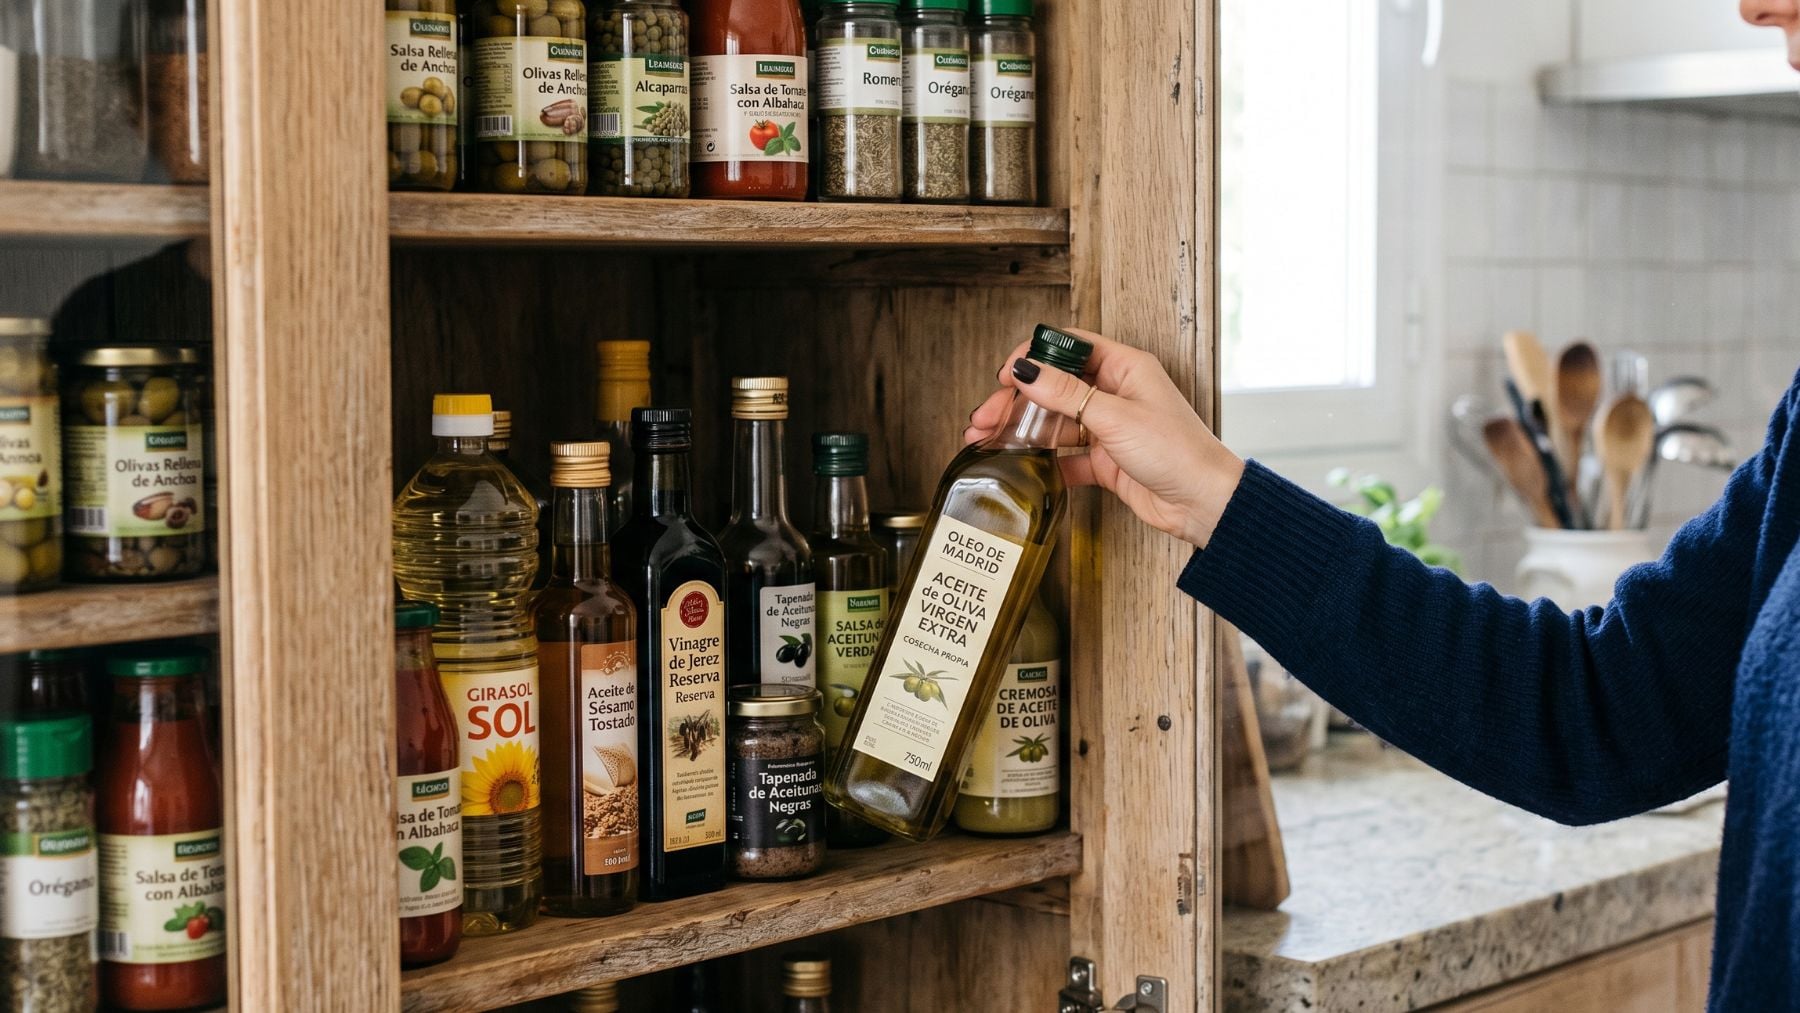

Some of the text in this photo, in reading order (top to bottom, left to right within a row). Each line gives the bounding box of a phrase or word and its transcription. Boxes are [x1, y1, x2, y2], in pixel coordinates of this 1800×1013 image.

[390, 43, 424, 57] Salsa
[400, 58, 418, 71] de
[522, 66, 561, 80] Olivas
[538, 81, 554, 94] de
[730, 83, 761, 95] Salsa
[763, 83, 778, 95] de
[737, 96, 805, 110] con Albahaca
[115, 458, 160, 473] Olivas
[131, 474, 150, 488] de
[947, 531, 1006, 563] OLEO DE
[942, 543, 999, 574] MADRID
[932, 572, 988, 602] ACEITE
[922, 586, 986, 620] de OLIVA
[766, 606, 779, 617] de
[921, 599, 978, 633] VIRGEN
[781, 617, 811, 629] Negras
[836, 620, 874, 631] SALSA
[827, 632, 879, 645] ACEITUN
[918, 617, 967, 647] EXTRA
[668, 636, 720, 652] Vinagre
[903, 635, 969, 668] COSECHA PROPIA
[669, 654, 719, 671] de Jerez
[669, 671, 720, 688] Reserva
[466, 682, 533, 702] GIRASOL
[588, 682, 635, 699] Aceite de
[675, 690, 716, 704] Reserva
[999, 685, 1057, 701] CREMOSA
[589, 699, 635, 715] Sésamo
[997, 699, 1057, 715] DE ACEITE
[467, 701, 536, 740] SOL
[588, 713, 635, 731] Tostado
[1000, 714, 1056, 729] DE OLIVA
[904, 751, 933, 772] 750ml
[759, 768, 817, 787] Tapenada
[748, 782, 822, 799] de Aceitunas
[418, 808, 435, 822] de
[769, 800, 811, 815] Negras
[135, 869, 176, 884] Salsa
[180, 867, 198, 882] de
[145, 889, 174, 901] con
